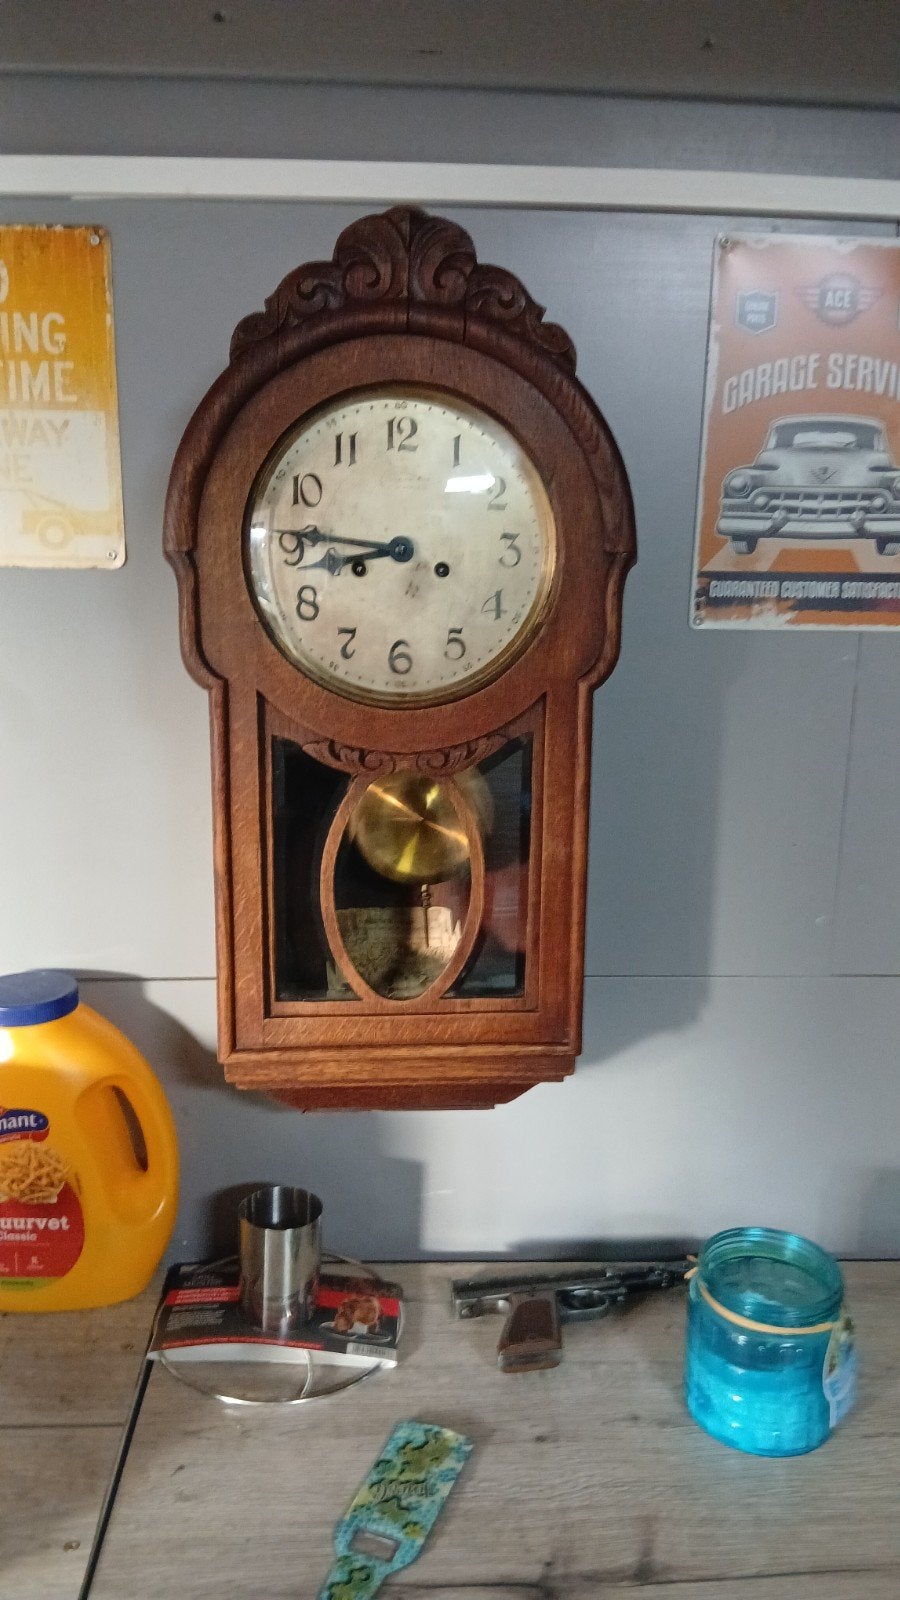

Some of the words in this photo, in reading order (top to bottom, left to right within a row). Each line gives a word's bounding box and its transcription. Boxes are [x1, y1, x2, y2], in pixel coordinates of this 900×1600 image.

[824, 289, 852, 309] ACE
[0, 360, 77, 402] IME
[722, 353, 821, 415] GARAGE
[333, 431, 359, 467] 11
[385, 415, 419, 452] 12
[452, 433, 462, 468] 1
[291, 472, 322, 508] 10
[487, 475, 509, 511] 2
[279, 531, 305, 566] 9
[498, 531, 521, 568] 3
[296, 584, 320, 622] 8
[480, 588, 508, 621] 4
[337, 626, 358, 660] 7
[388, 638, 413, 675] 6
[443, 626, 466, 660] 5
